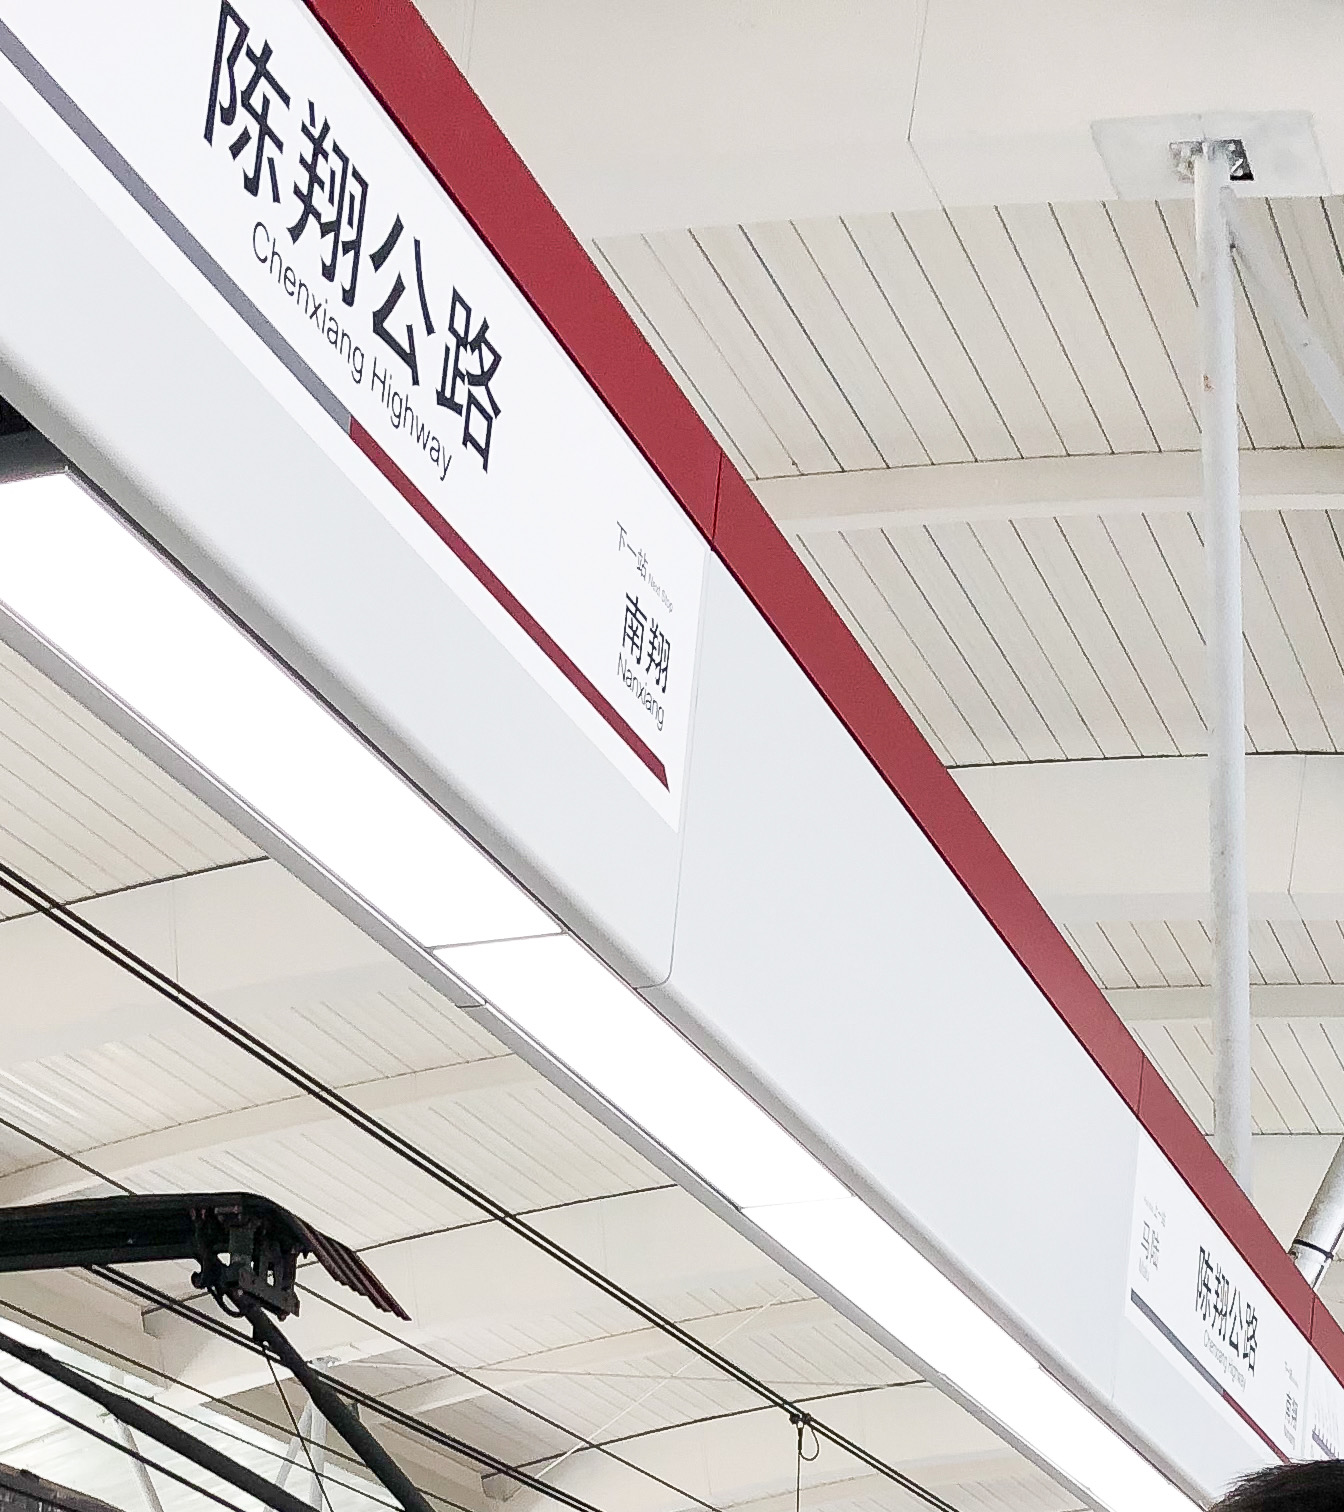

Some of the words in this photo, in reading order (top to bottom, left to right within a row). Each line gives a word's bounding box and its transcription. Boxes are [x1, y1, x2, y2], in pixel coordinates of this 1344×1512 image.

[203, 0, 502, 473] 陈翔公路
[252, 221, 366, 384] Chenxiang
[371, 356, 453, 482] Highway
[616, 520, 649, 581] 下一站
[617, 651, 665, 731] Nanxiang
[622, 591, 671, 694] 南翔
[1195, 1244, 1258, 1378] 陈翔公路
